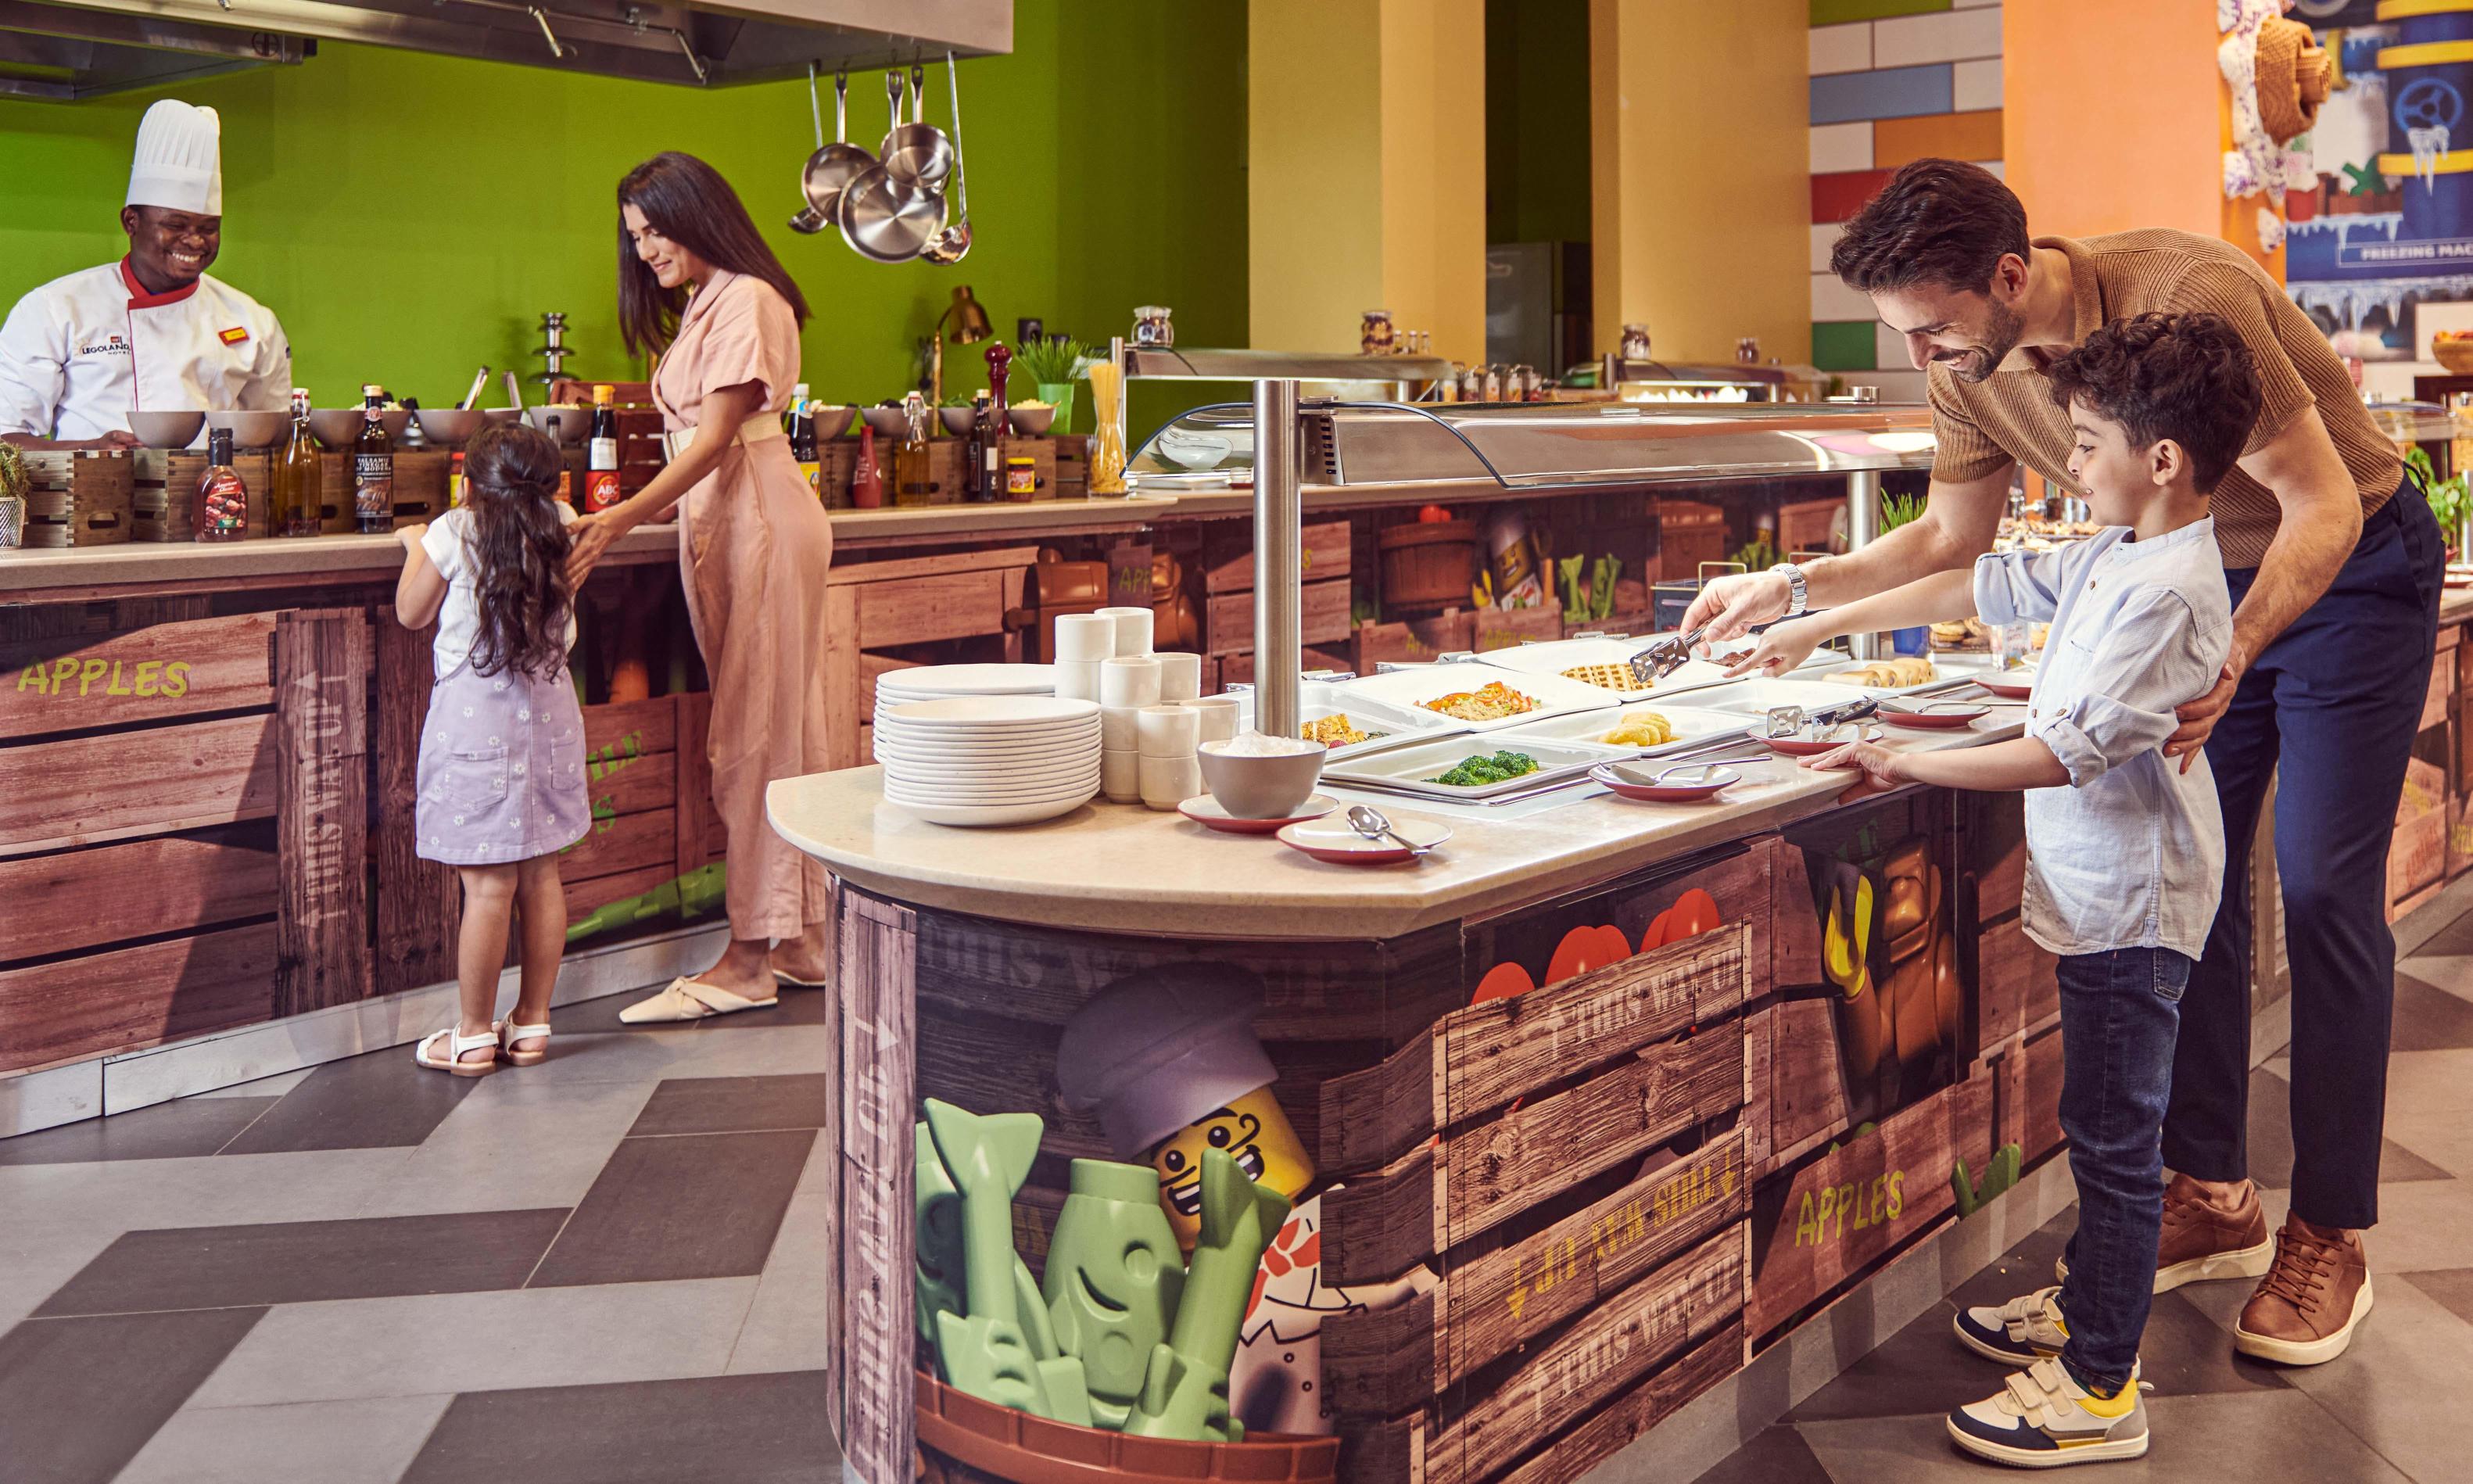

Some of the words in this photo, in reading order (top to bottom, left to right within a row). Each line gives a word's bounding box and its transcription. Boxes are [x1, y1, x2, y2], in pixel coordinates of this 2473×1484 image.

[2361, 244, 2435, 261] FREEZING
[82, 336, 131, 354] LEGOLAND
[597, 484, 618, 495] ABC
[16, 655, 191, 697] APPLES
[304, 697, 342, 740] UP
[1572, 980, 1642, 1045] THIS
[1650, 959, 1706, 1013] WAY
[858, 1063, 889, 1145] UP
[1653, 1163, 1715, 1228] THIS
[1795, 1170, 1905, 1247] APPLES
[1535, 1236, 1577, 1295] UP
[1555, 1316, 1631, 1396] THIS
[1640, 1272, 1696, 1346] WAY
